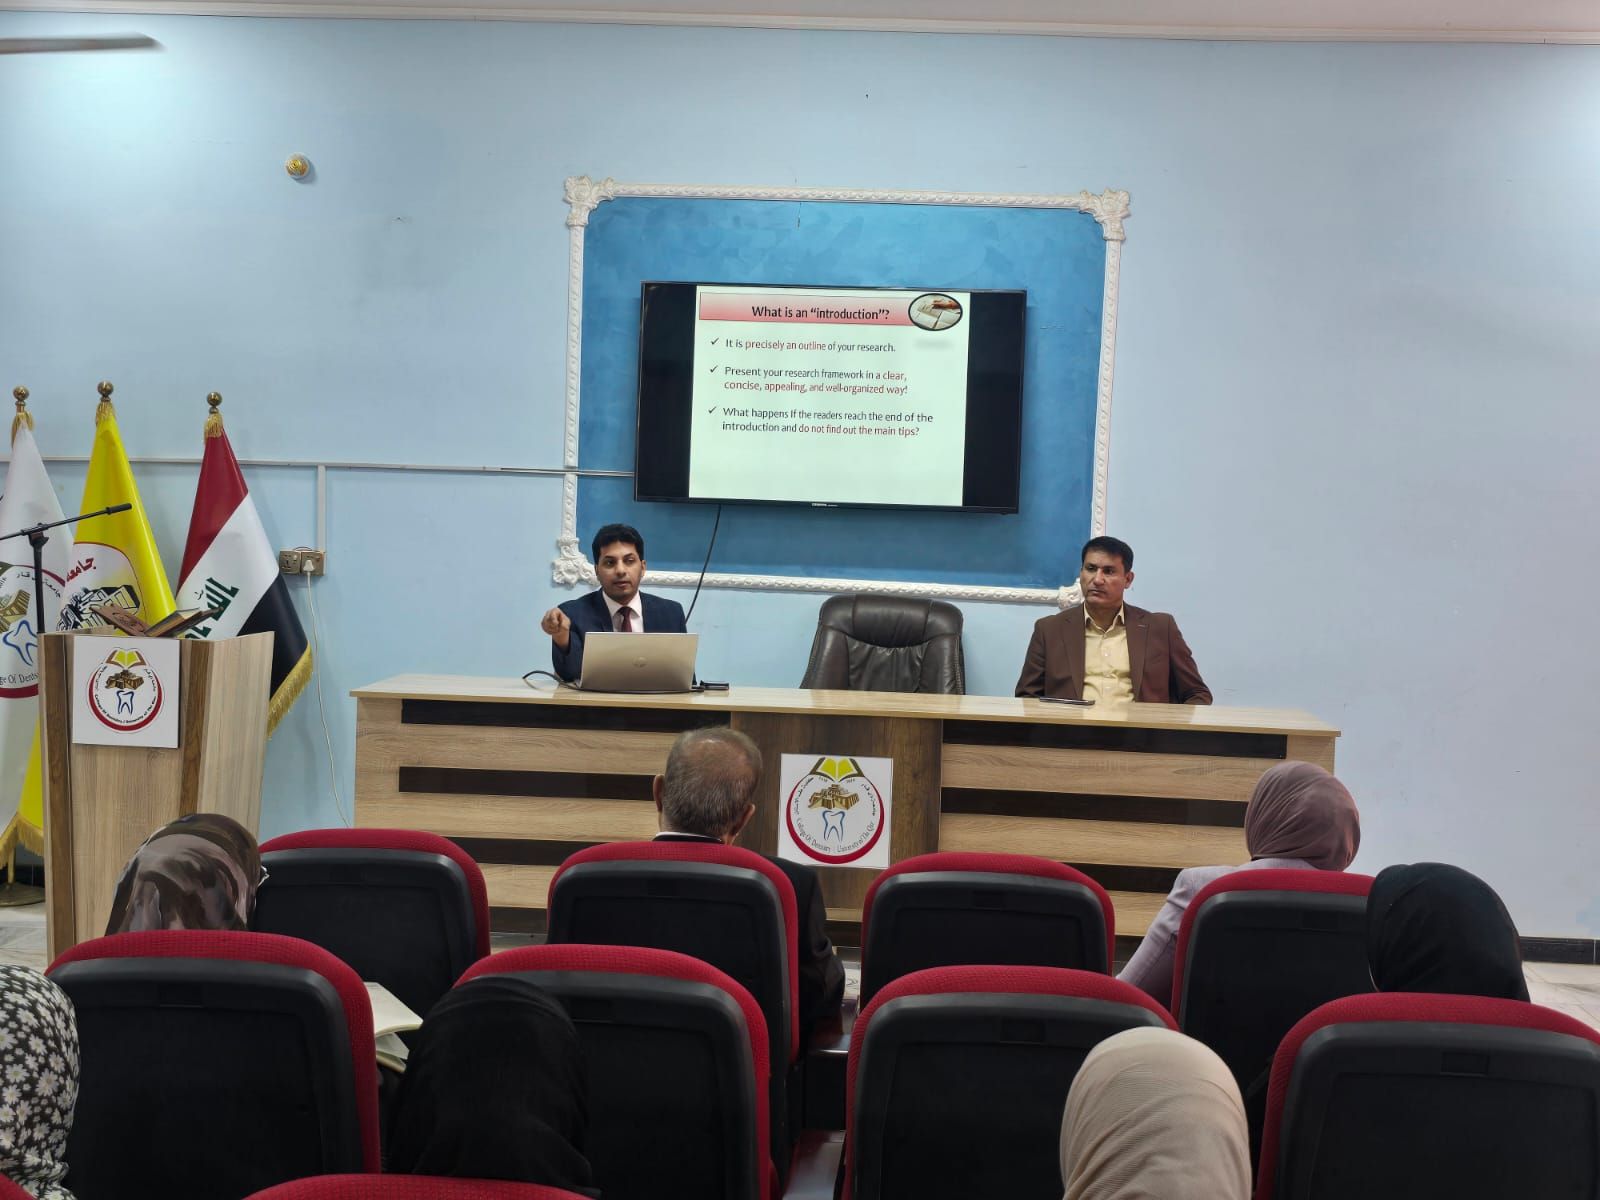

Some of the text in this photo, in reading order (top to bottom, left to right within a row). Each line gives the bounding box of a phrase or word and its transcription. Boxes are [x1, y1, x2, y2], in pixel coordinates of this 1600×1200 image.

[752, 306, 781, 318] What
[785, 307, 792, 318] is
[796, 309, 807, 318] an
[726, 339, 733, 347] It
[736, 339, 743, 347] is
[746, 340, 784, 350] precisely
[799, 341, 826, 351] outline
[828, 341, 836, 351] of
[837, 344, 855, 352] your
[857, 343, 895, 352] research.
[725, 367, 761, 376] Present
[763, 369, 782, 378] your
[785, 369, 819, 378] research
[821, 369, 864, 379] framework
[866, 371, 874, 379] in
[875, 372, 881, 380] a
[809, 383, 823, 391] and
[723, 408, 749, 417] What
[752, 408, 788, 419] happens
[799, 410, 812, 419] the
[814, 411, 842, 420] readers
[844, 411, 867, 420] reach
[869, 412, 883, 421] the
[885, 413, 902, 421] end
[905, 413, 914, 421] of
[917, 413, 933, 422] the
[723, 422, 919, 437] introduction and do not find out the main tips?
